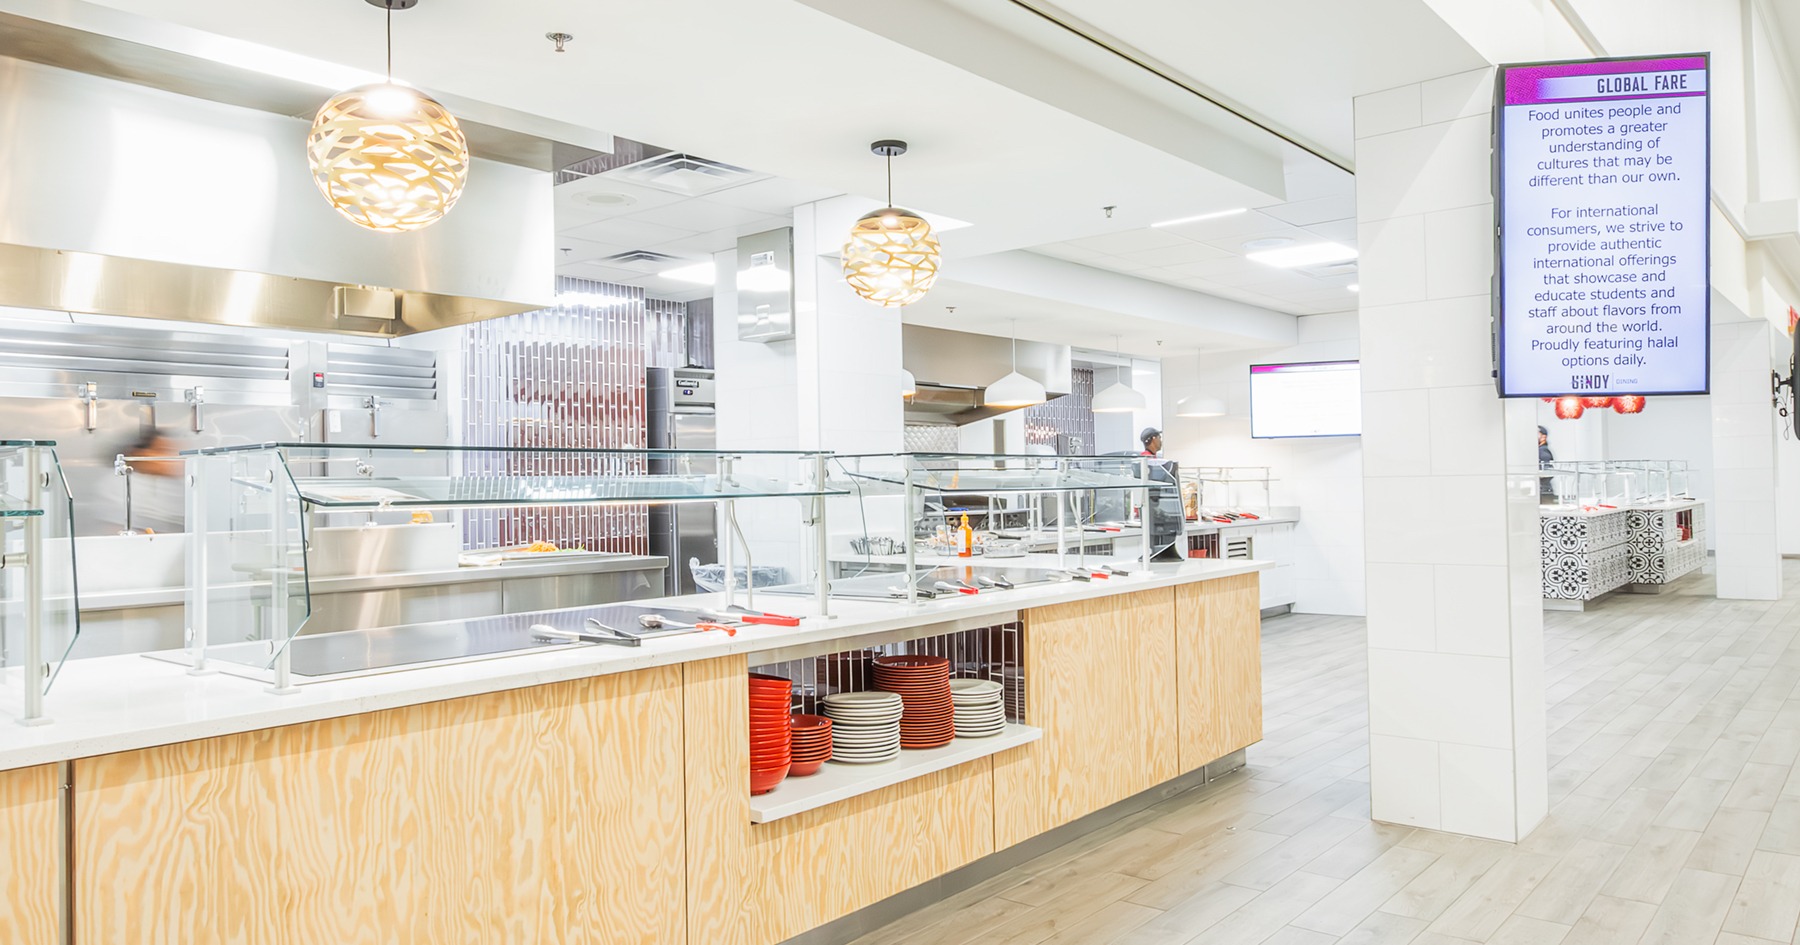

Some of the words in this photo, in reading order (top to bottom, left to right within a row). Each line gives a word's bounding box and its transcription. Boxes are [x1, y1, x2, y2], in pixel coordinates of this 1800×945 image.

[1597, 76, 1648, 94] GLOBAL
[1654, 74, 1688, 91] FARE
[1527, 108, 1560, 122] Food
[1564, 107, 1604, 120] unites
[1608, 104, 1653, 119] people
[1656, 102, 1682, 115] and
[1541, 123, 1603, 139] promotes
[1607, 124, 1615, 134] a
[1620, 121, 1668, 136] greater
[1549, 138, 1643, 154] understanding
[1646, 136, 1661, 149] of
[1537, 156, 1589, 171] cultures
[1593, 156, 1620, 168] that
[1623, 155, 1652, 168] may
[1656, 153, 1673, 165] be
[1528, 173, 1584, 187] different
[1588, 172, 1618, 184] than
[1621, 172, 1644, 183] our
[1648, 171, 1681, 182] own.
[1550, 207, 1572, 219] For
[1576, 203, 1659, 218] international
[1526, 223, 1602, 237] consumers,
[1606, 223, 1625, 233] we
[1629, 221, 1666, 233] strive
[1669, 220, 1684, 231] to
[1548, 239, 1596, 254] provide
[1600, 237, 1662, 250] authentic
[1533, 255, 1615, 269] international
[1619, 254, 1677, 268] offerings
[1543, 273, 1570, 285] that
[1573, 271, 1637, 284] showcase
[1641, 269, 1666, 282] and
[1534, 289, 1586, 302] educate
[1590, 287, 1647, 300] students
[1650, 286, 1675, 299] and
[1528, 306, 1558, 319] staff
[1561, 305, 1598, 317] about
[1603, 303, 1647, 316] flavors
[1650, 302, 1682, 315] from
[1546, 321, 1592, 334] around
[1596, 321, 1618, 333] the
[1622, 320, 1662, 332] world.
[1531, 338, 1580, 352] Proudly
[1584, 336, 1643, 352] featuring
[1647, 335, 1679, 348] halal
[1561, 354, 1610, 369] options
[1613, 353, 1647, 367] daily.
